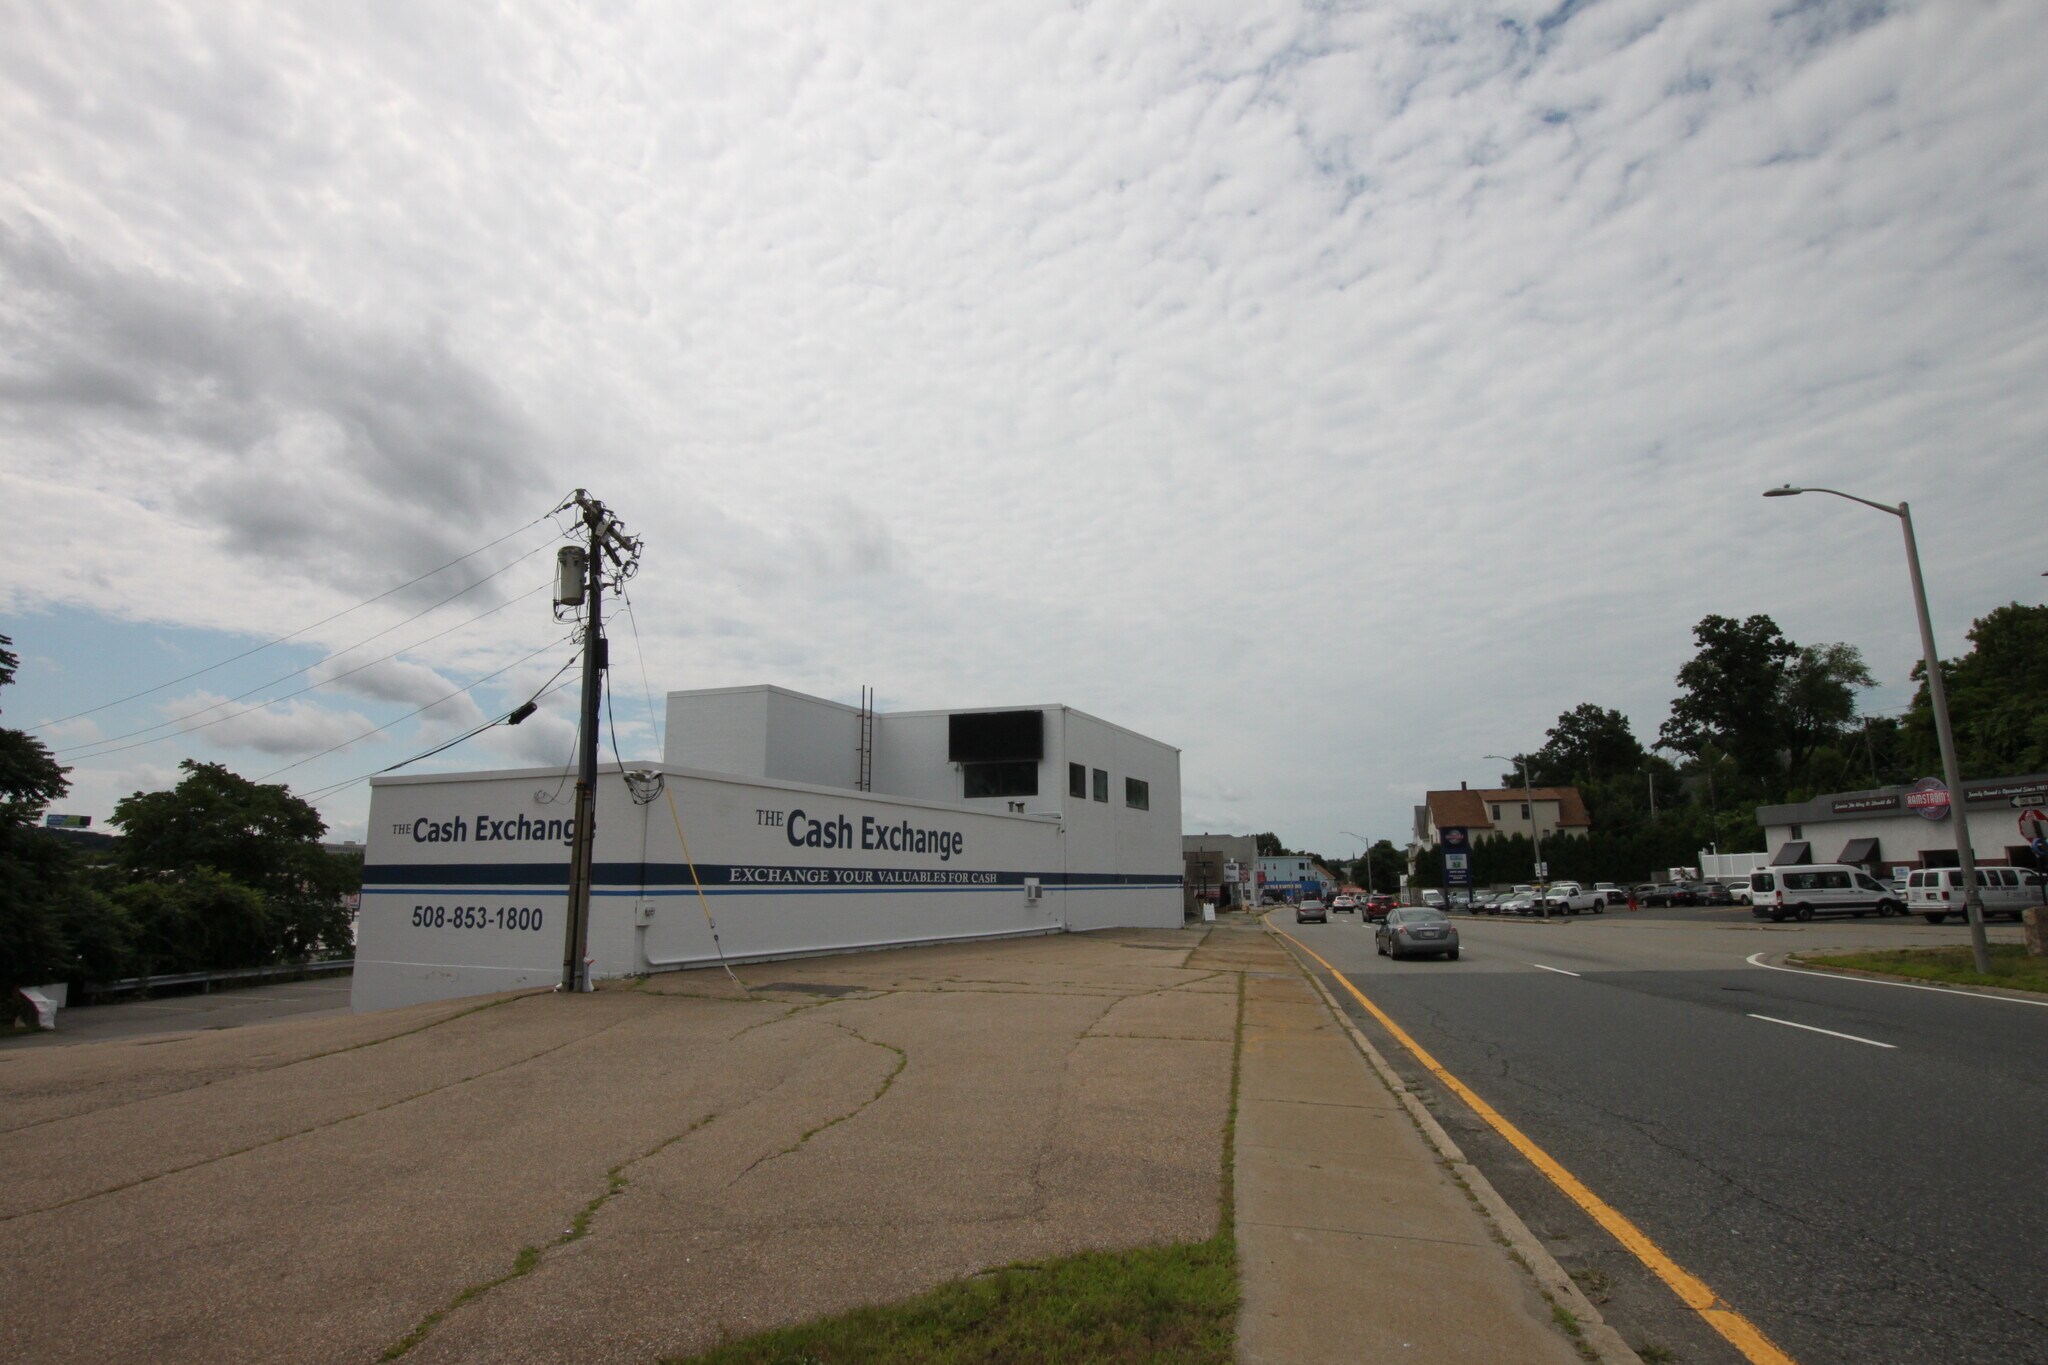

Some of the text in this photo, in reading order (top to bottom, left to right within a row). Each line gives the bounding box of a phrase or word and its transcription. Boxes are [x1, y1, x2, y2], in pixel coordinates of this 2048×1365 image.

[392, 814, 597, 847] THE Cash Exchang
[756, 809, 963, 861] THE Cash Exchange
[729, 868, 997, 883] EXCHANGE YOUR VALUABLES FOR CASH
[412, 905, 543, 932] 508-853-1800
